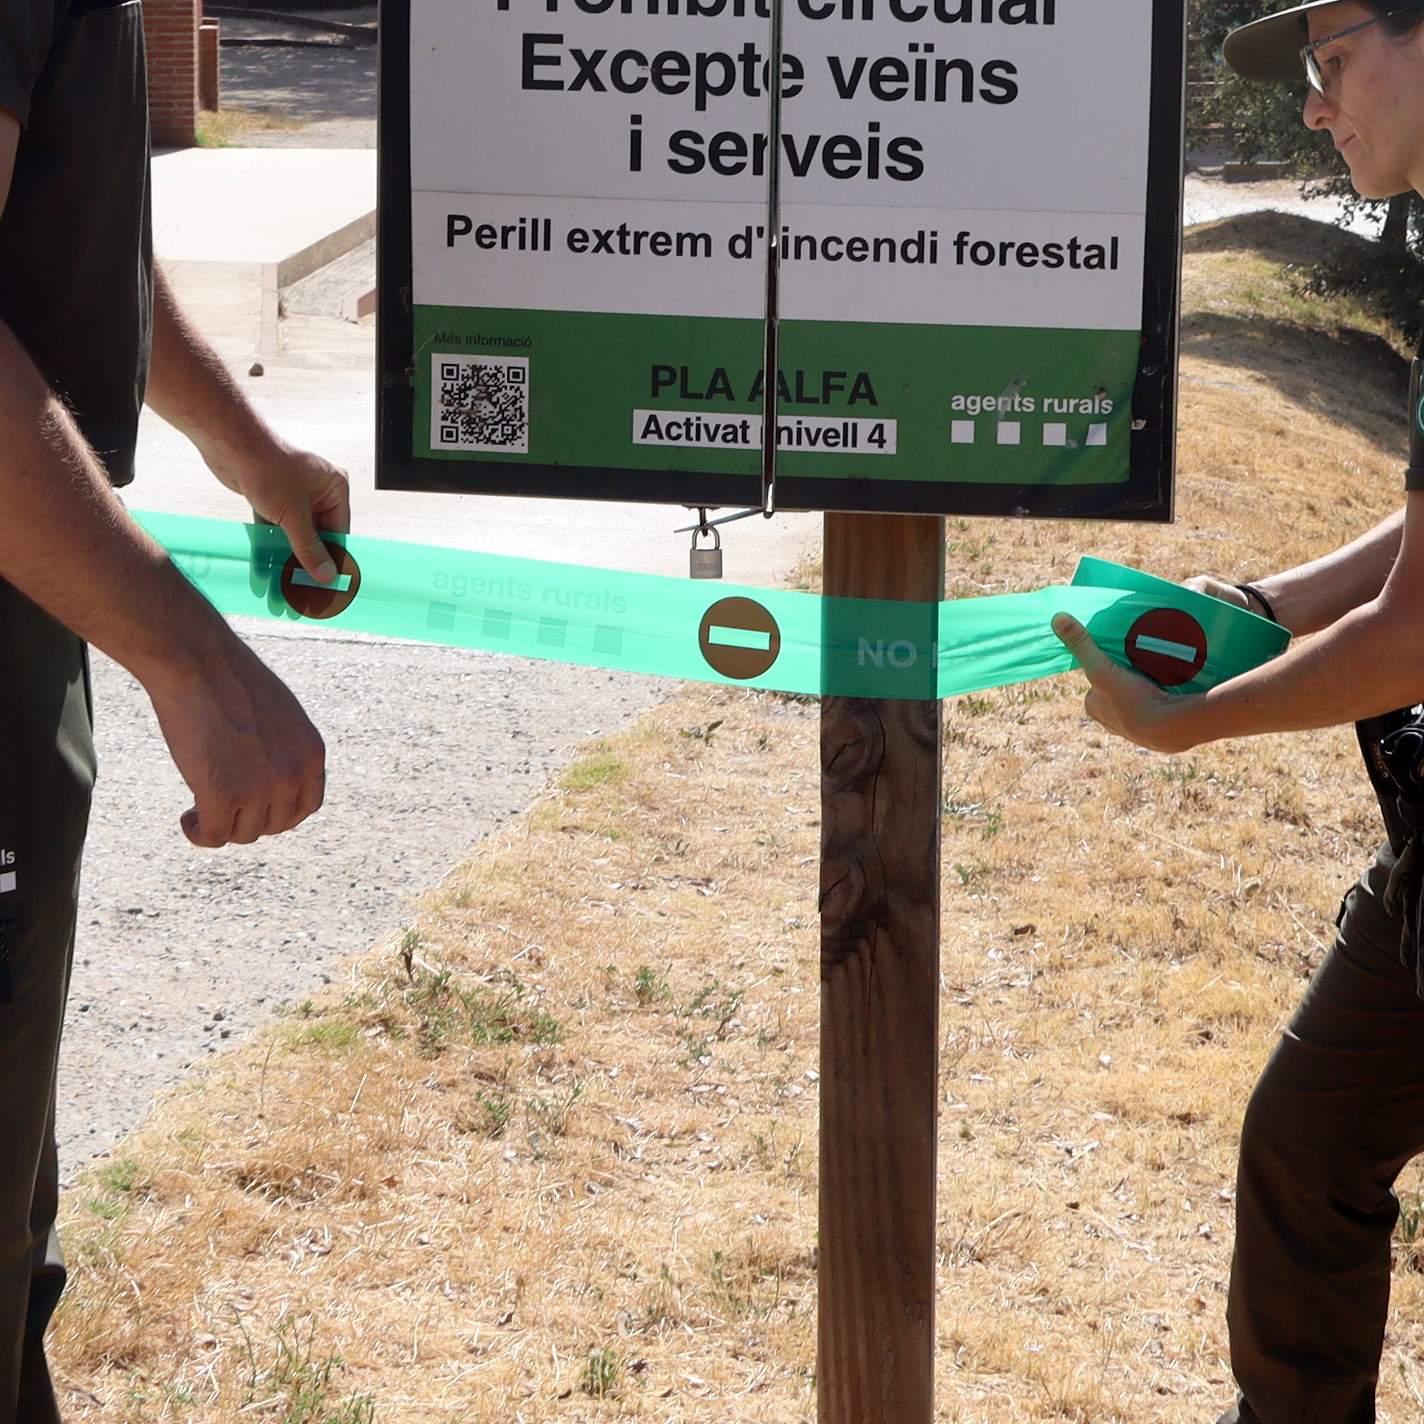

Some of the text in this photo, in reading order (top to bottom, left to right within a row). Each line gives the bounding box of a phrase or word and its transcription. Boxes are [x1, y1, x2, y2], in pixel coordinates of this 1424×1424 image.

[521, 33, 1019, 111] Excepte veïns
[628, 115, 925, 182] i serveis
[445, 214, 552, 253] Perill
[566, 221, 712, 259] extrem
[953, 233, 1119, 270] forestal
[466, 334, 532, 347] informació
[651, 365, 878, 406] PLA ALFA
[951, 393, 1113, 415] agents rurals
[641, 414, 749, 444] Activat
[868, 423, 886, 448] 4
[432, 567, 627, 614] agents rurals
[856, 637, 918, 669] NO
